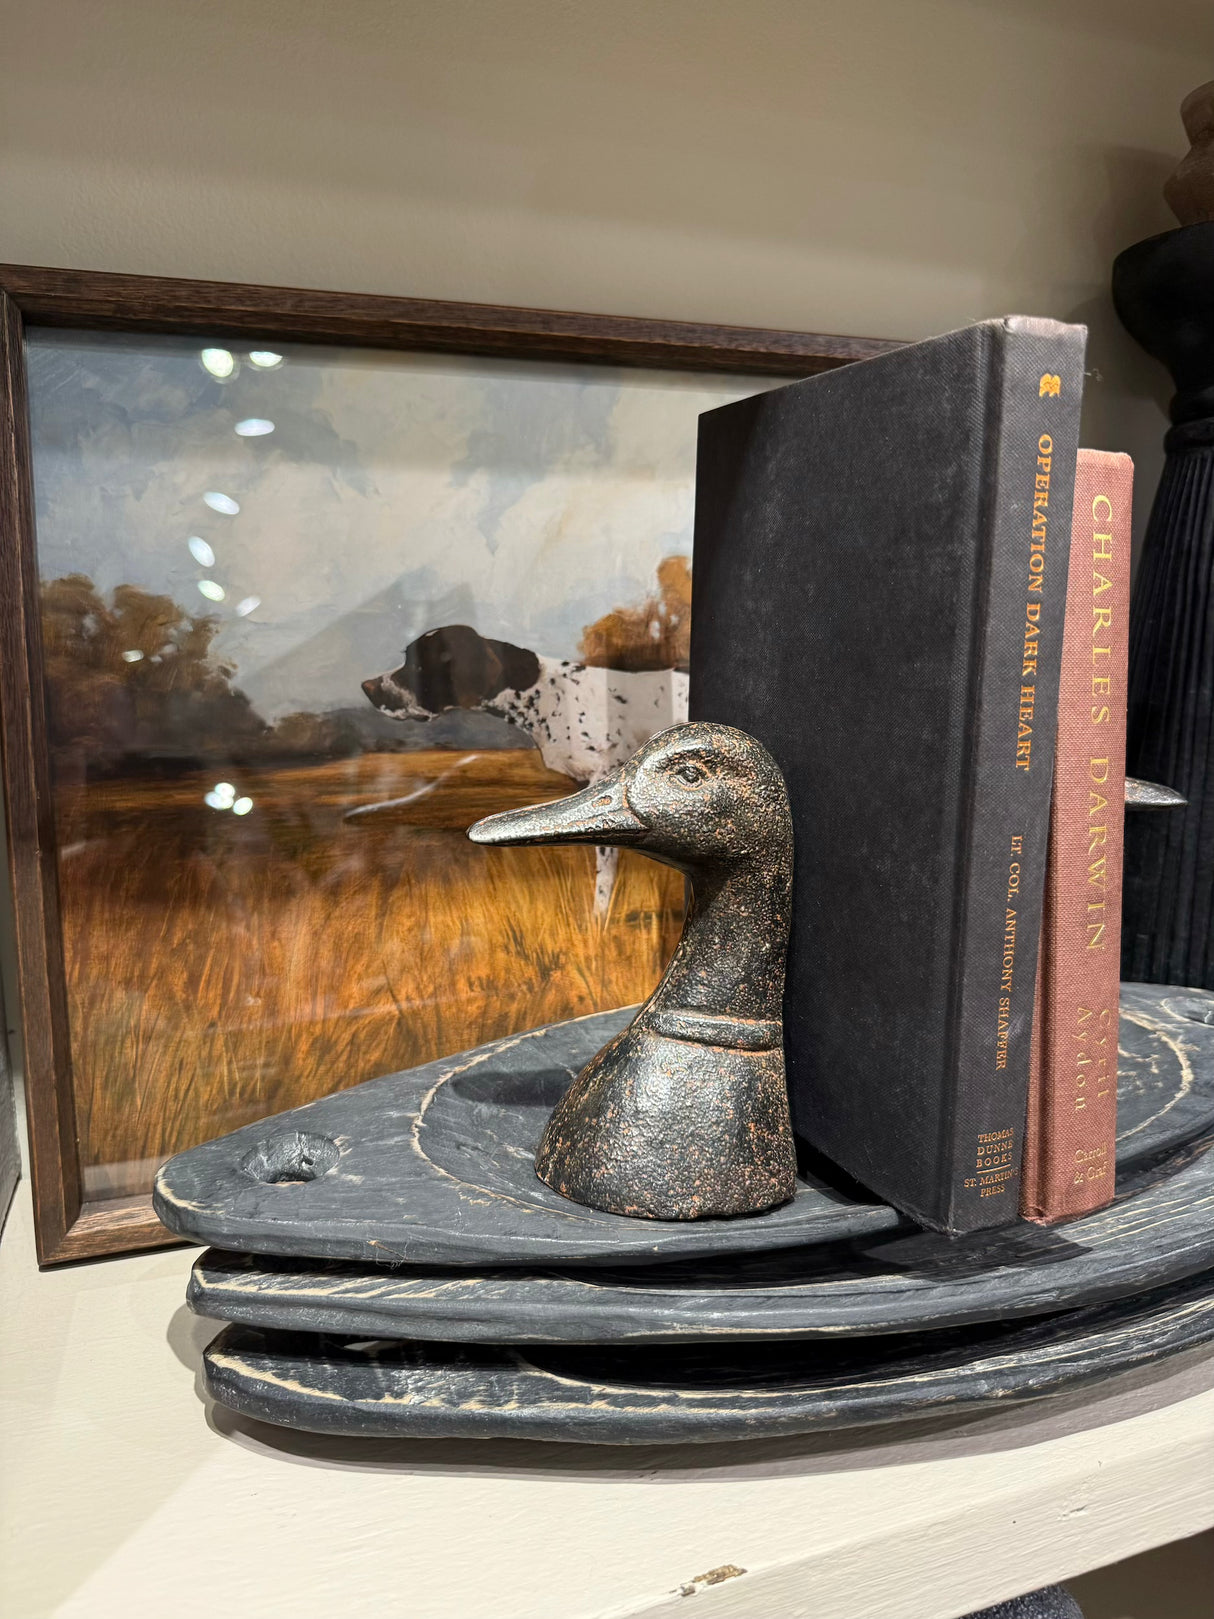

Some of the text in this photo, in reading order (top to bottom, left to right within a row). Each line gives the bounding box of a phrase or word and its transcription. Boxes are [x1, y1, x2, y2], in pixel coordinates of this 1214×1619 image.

[1015, 434, 1053, 772] OPERATION DARK HEART
[1087, 494, 1114, 950] CHARLES DARWIN
[995, 835, 1023, 1070] LT. COL. ANTHONY SHAFFER
[1071, 1007, 1092, 1110] Aydon
[1095, 1008, 1111, 1097] Cyril
[975, 1152, 1013, 1168] BOOKS
[976, 1139, 1014, 1156] DUNNE
[977, 1127, 1014, 1143] THOMAS
[963, 1178, 977, 1188] ST.
[980, 1183, 1005, 1198] PRESS
